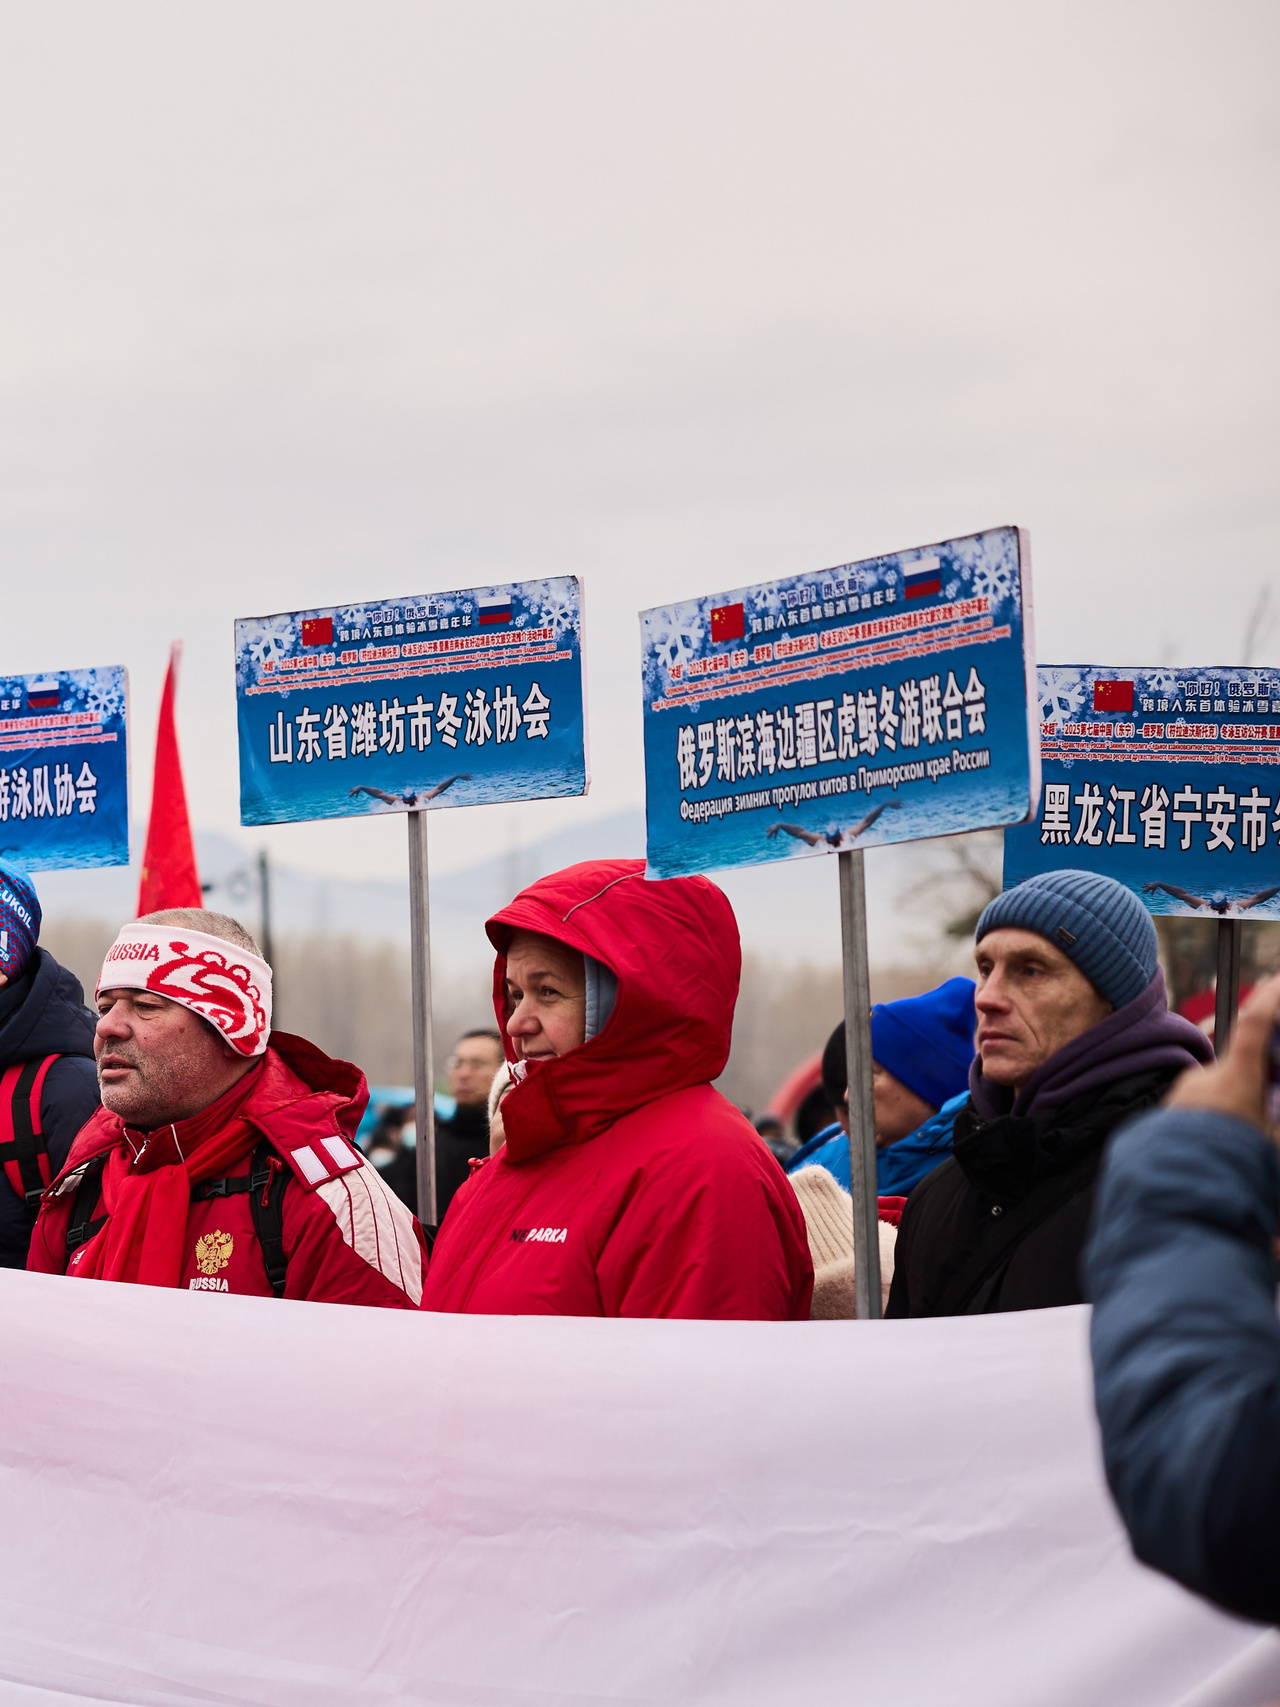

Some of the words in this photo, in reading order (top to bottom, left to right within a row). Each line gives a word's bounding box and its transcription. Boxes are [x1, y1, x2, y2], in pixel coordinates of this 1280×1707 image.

[268, 682, 551, 764] 山东省潍坊市冬泳协会
[676, 666, 986, 789] 俄罗斯滨海边疆区虎鲸冬游联合会
[680, 796, 734, 823] Федерация
[734, 788, 771, 812] зимних
[772, 781, 818, 808] прогулок
[819, 774, 849, 797] китов
[850, 776, 857, 791] в
[858, 761, 925, 789] Приморском
[926, 757, 951, 782] крае
[952, 748, 990, 772] России
[1040, 782, 1280, 852] 黑龙江省宁安市
[105, 942, 160, 962] RUSSIA
[189, 1277, 229, 1292] RUSSIA
